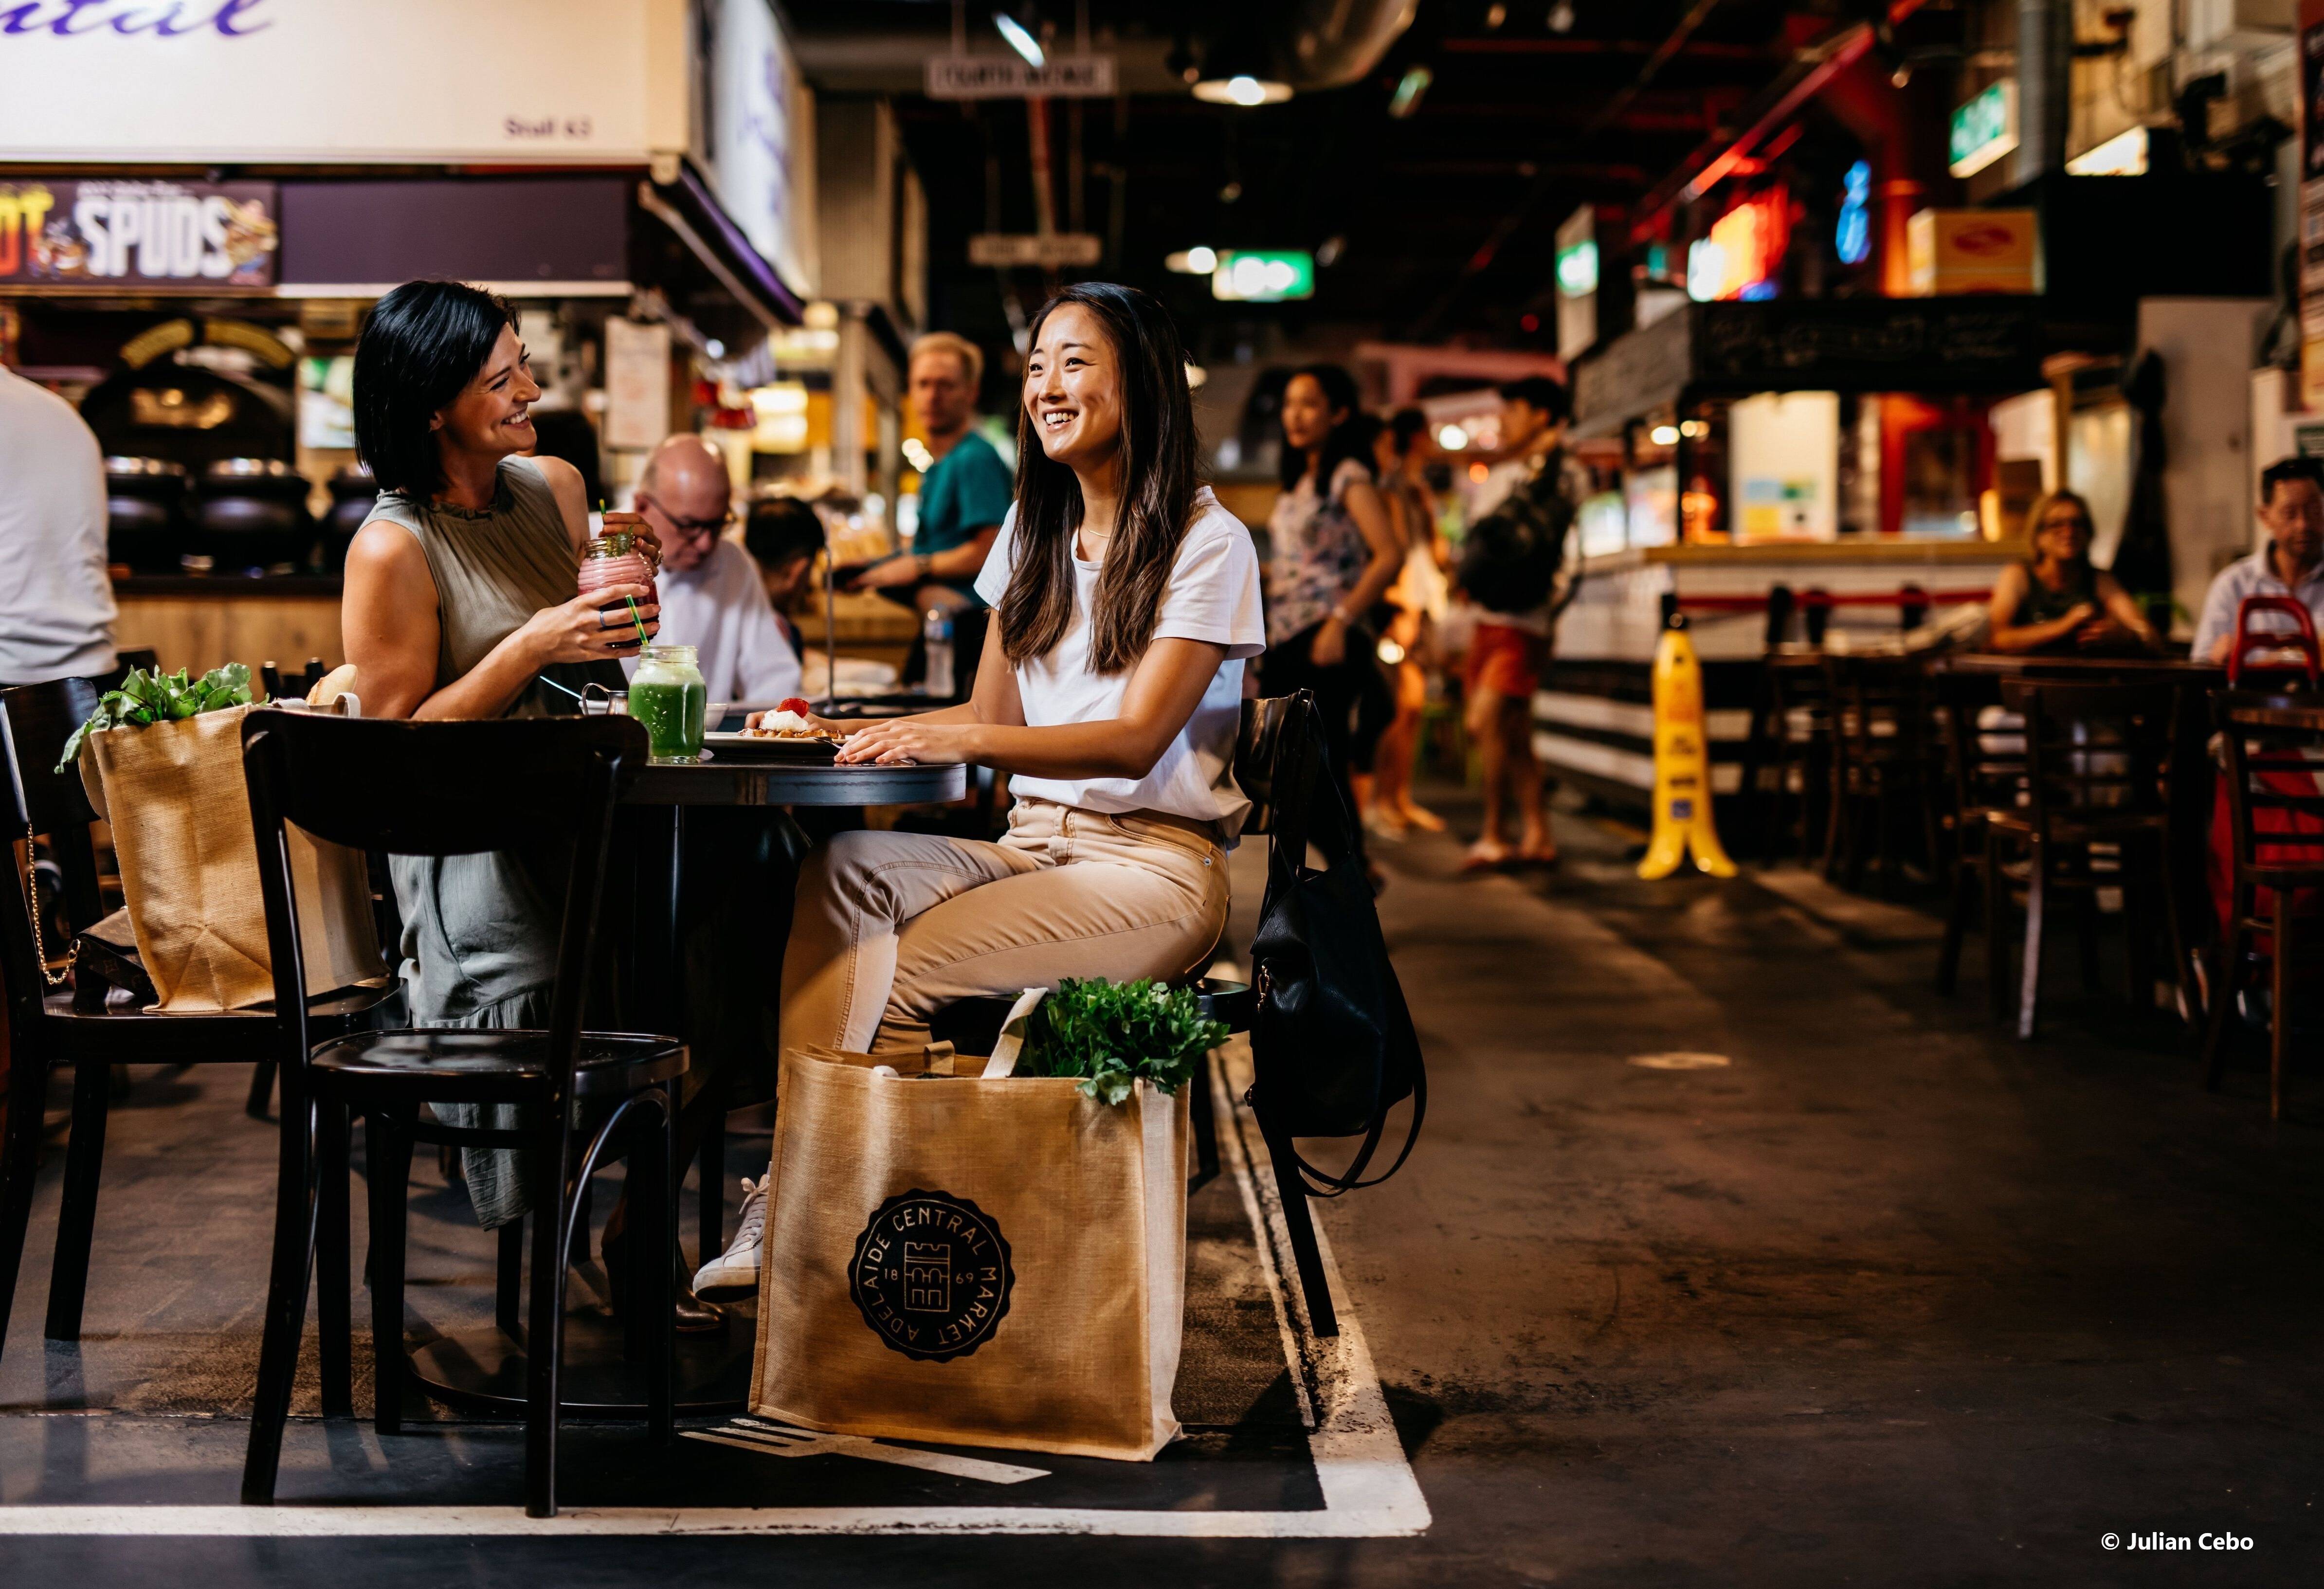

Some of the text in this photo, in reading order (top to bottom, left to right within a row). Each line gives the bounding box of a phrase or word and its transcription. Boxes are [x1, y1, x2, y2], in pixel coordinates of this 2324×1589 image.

[75, 195, 235, 278] SPUDS
[864, 1207, 997, 1345] ADELAIDE CENTRAL MARKET
[884, 1268, 974, 1284] 18 69
